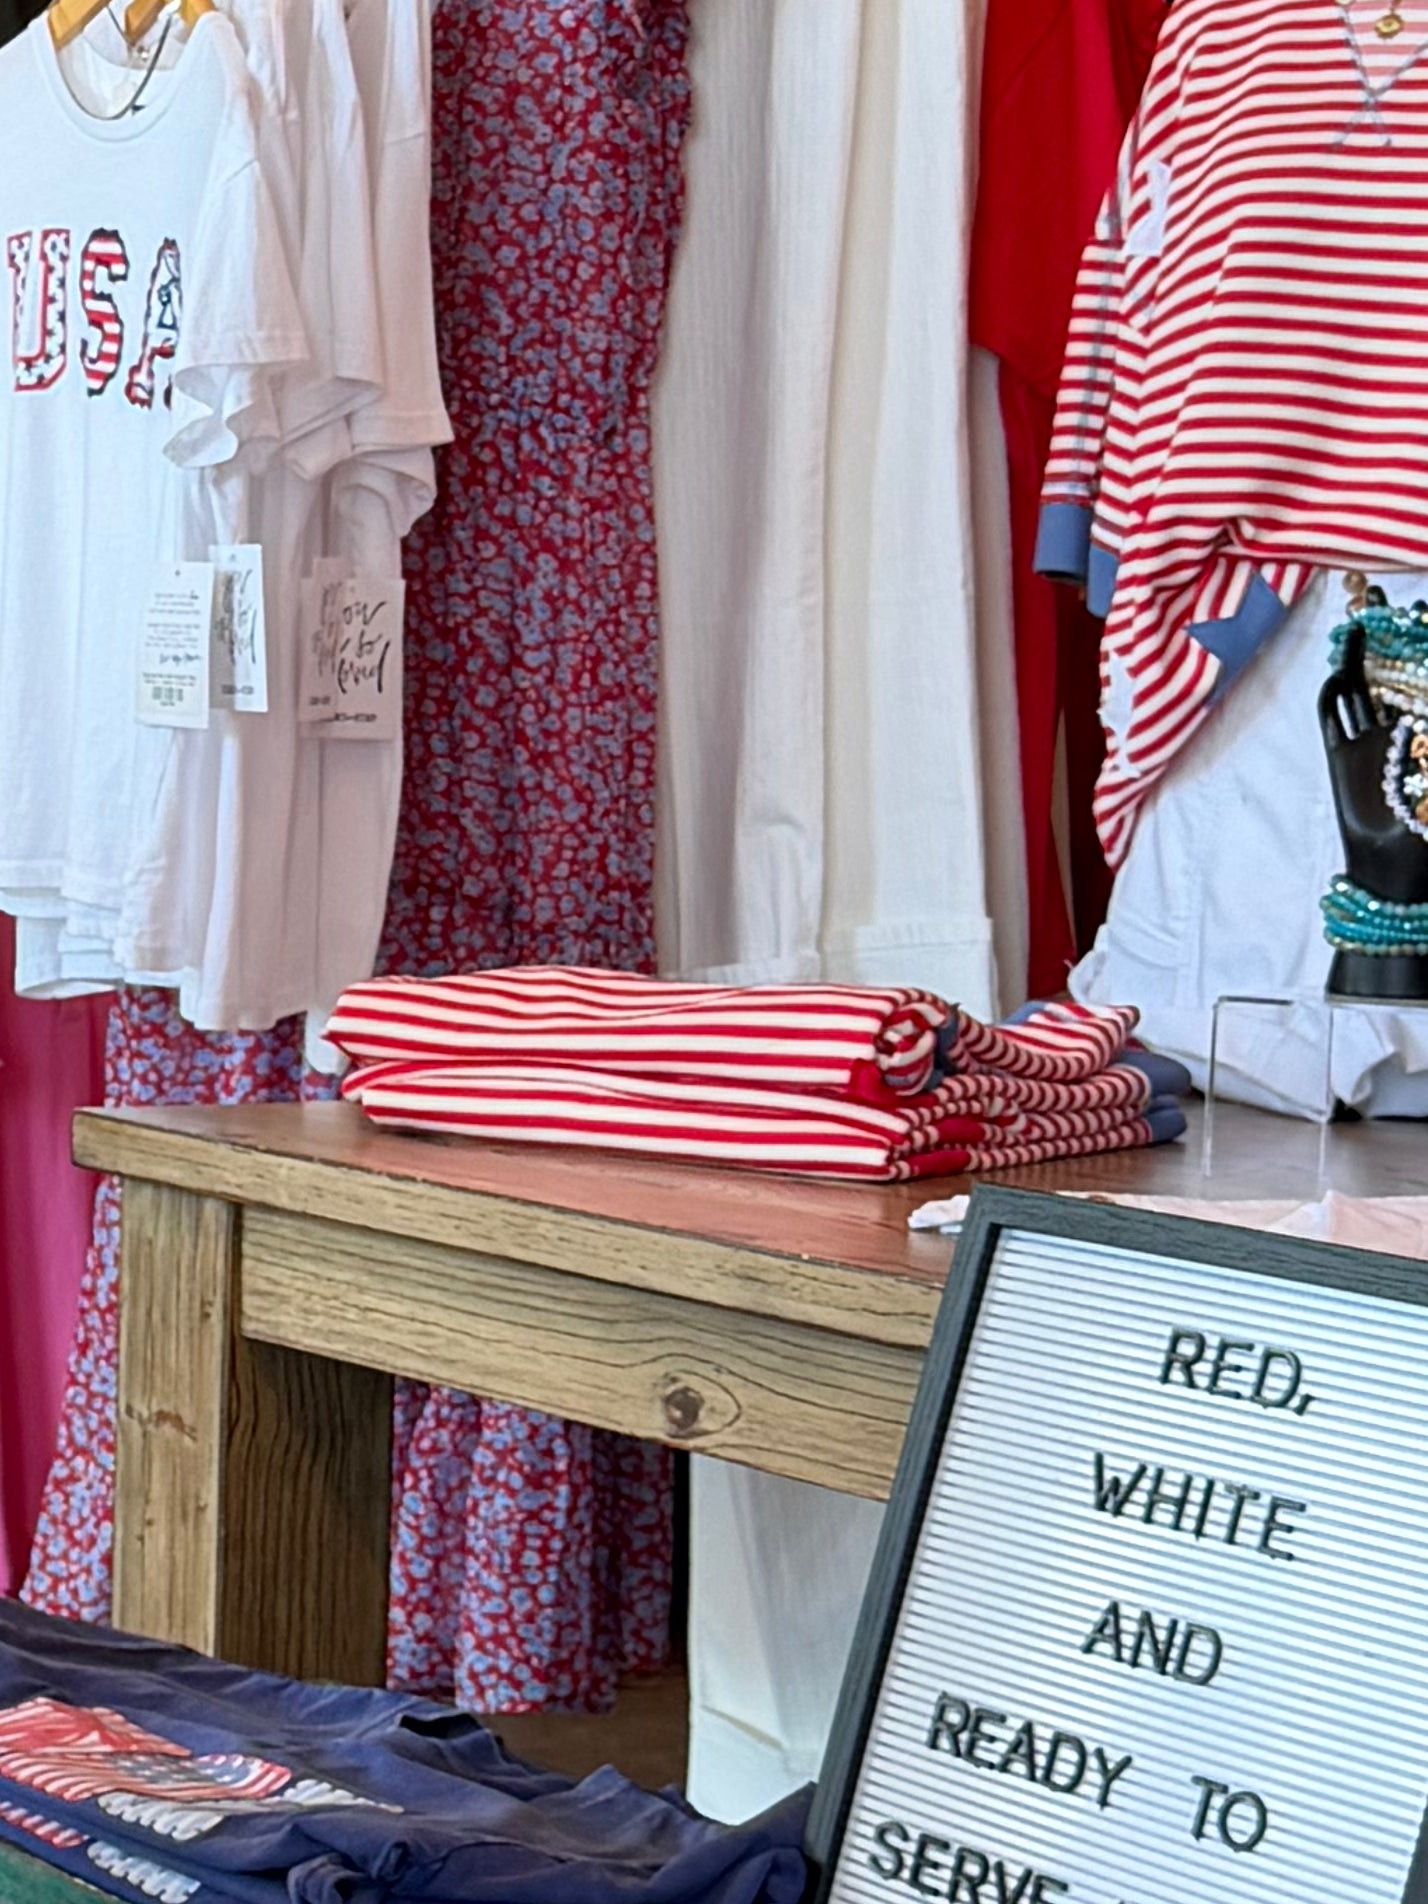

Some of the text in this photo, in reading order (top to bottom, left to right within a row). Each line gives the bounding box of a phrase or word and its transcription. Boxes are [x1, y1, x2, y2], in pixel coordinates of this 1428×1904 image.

[6, 227, 183, 411] USA
[1158, 1326, 1318, 1416] RED,
[1092, 1450, 1307, 1561] WHITE
[1080, 1600, 1225, 1686] AND
[926, 1690, 1269, 1853] READY TO
